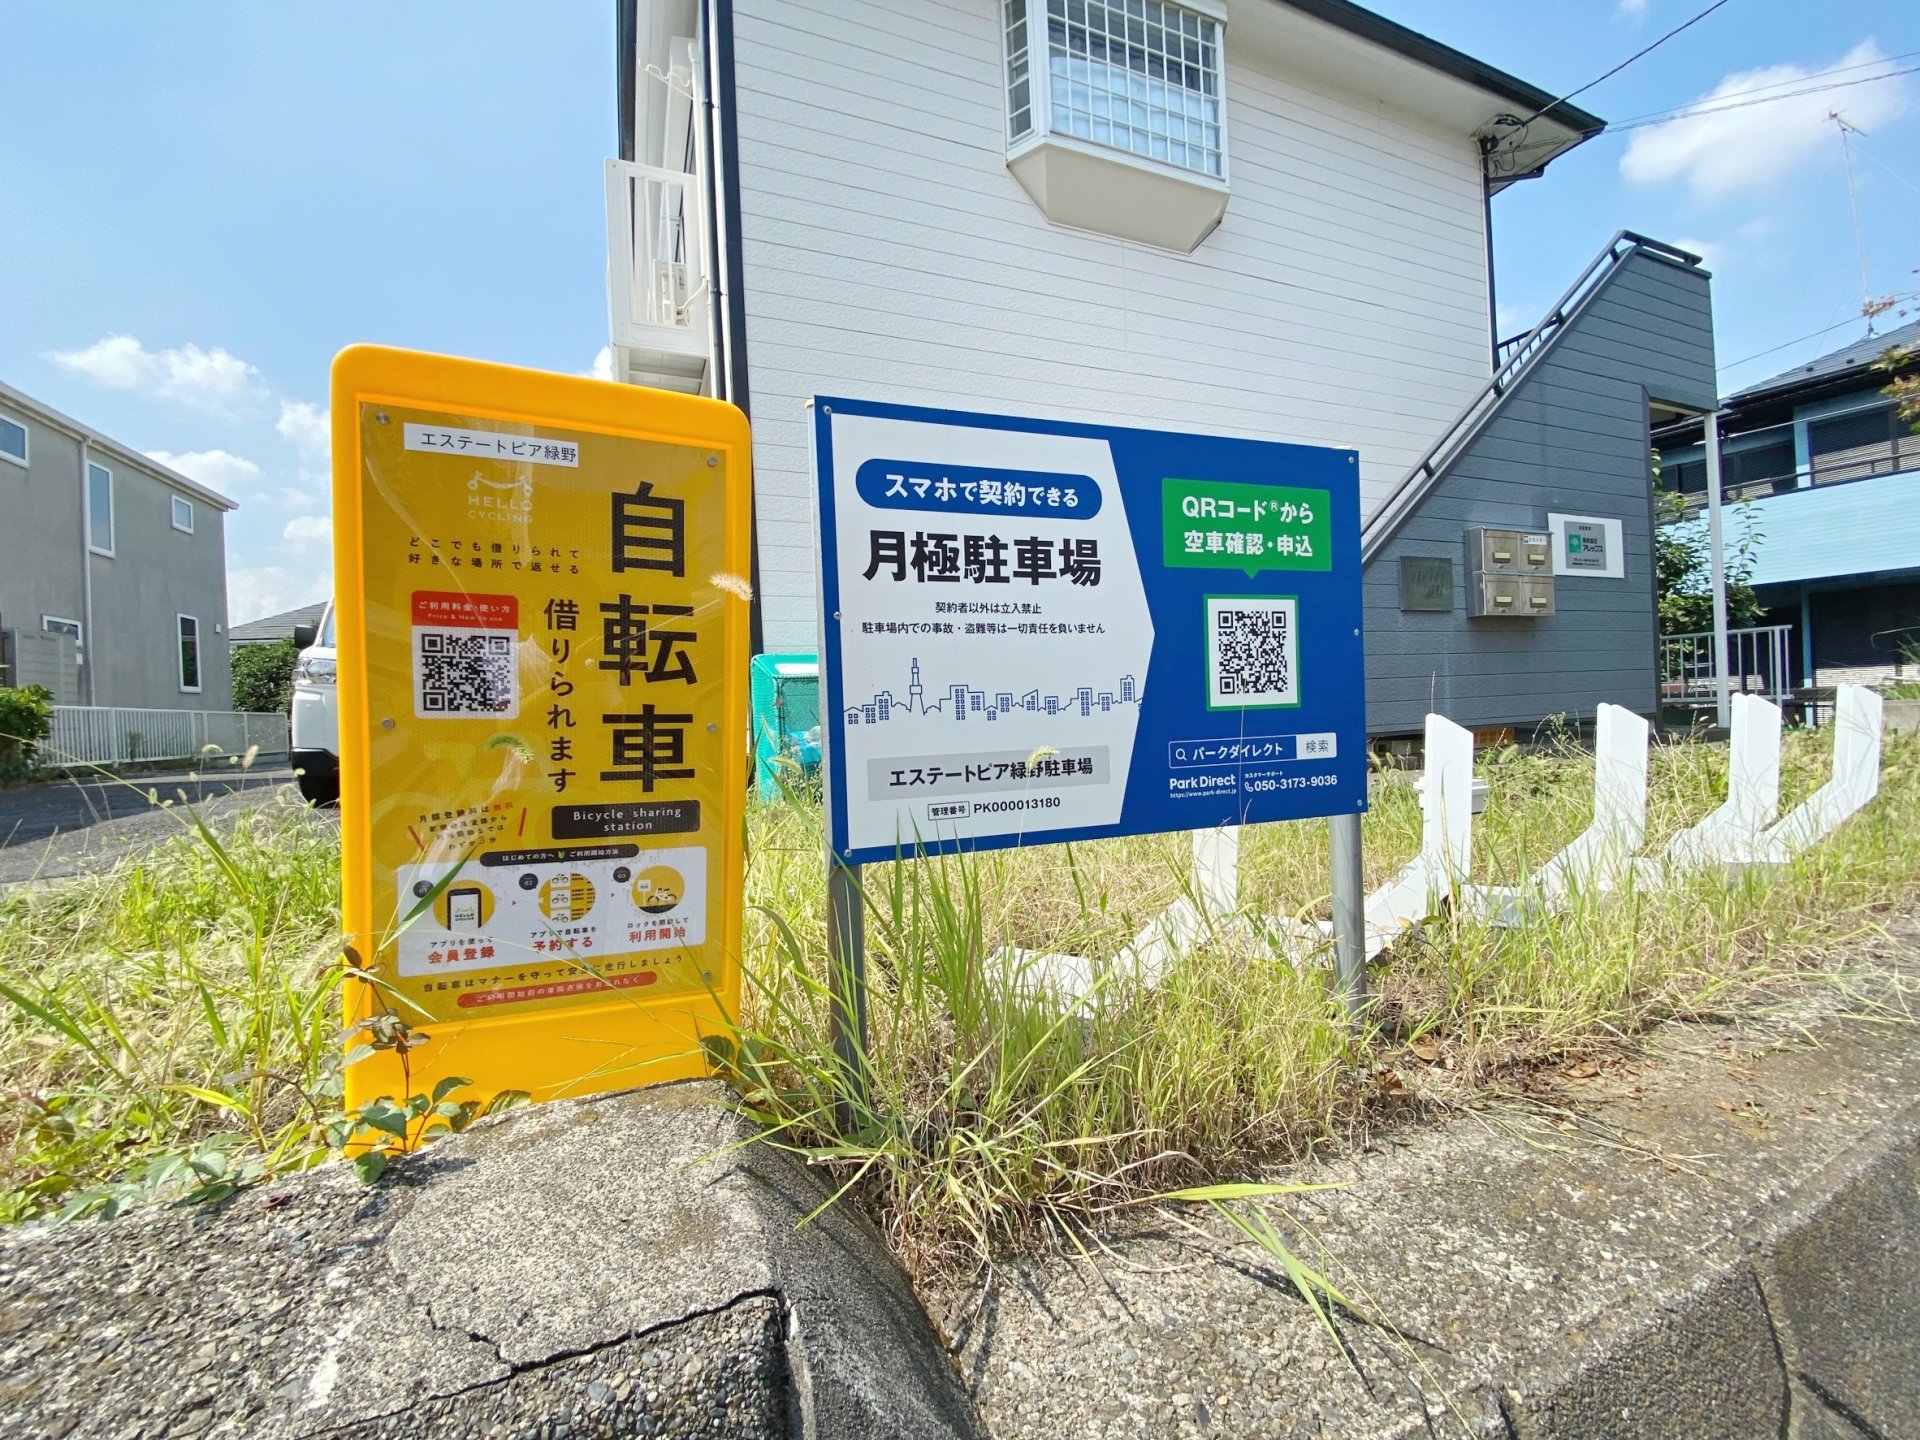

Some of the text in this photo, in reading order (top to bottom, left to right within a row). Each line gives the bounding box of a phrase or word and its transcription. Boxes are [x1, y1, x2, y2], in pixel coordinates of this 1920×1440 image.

[421, 431, 577, 463] エステートピア緑野
[885, 473, 1080, 508] スマホで契約できる
[468, 495, 533, 512] HELLO
[468, 510, 533, 523] CYCLING
[409, 536, 580, 559] どこでも借りられて
[1184, 530, 1313, 557] 空車確認・申込
[409, 552, 580, 575] 好きな場所で返せる
[863, 530, 1102, 587] 月極駐車場
[418, 600, 511, 614] ご利用料金・使い方
[935, 601, 1042, 614] 契約者以外は立入禁止
[599, 481, 698, 793] 自転車
[862, 621, 1105, 635] 駐車場内での事故・盗難等は一切責任を負いません
[543, 598, 580, 793] 借りられます
[1192, 739, 1329, 761] パークダイレクト 検索
[889, 757, 1094, 787] エステートピア緑野駐車場
[1169, 773, 1236, 790] Park Direct
[1254, 775, 1338, 791] 050-3173-9036
[573, 806, 682, 822] Bicycle sharing
[931, 797, 1061, 816] 管理番号 PK000013180
[604, 819, 653, 832] station
[530, 926, 597, 938] アプリで自転車を
[629, 927, 687, 943] 利用開始
[533, 937, 594, 953] 予約する
[428, 945, 495, 964] 会員登録
